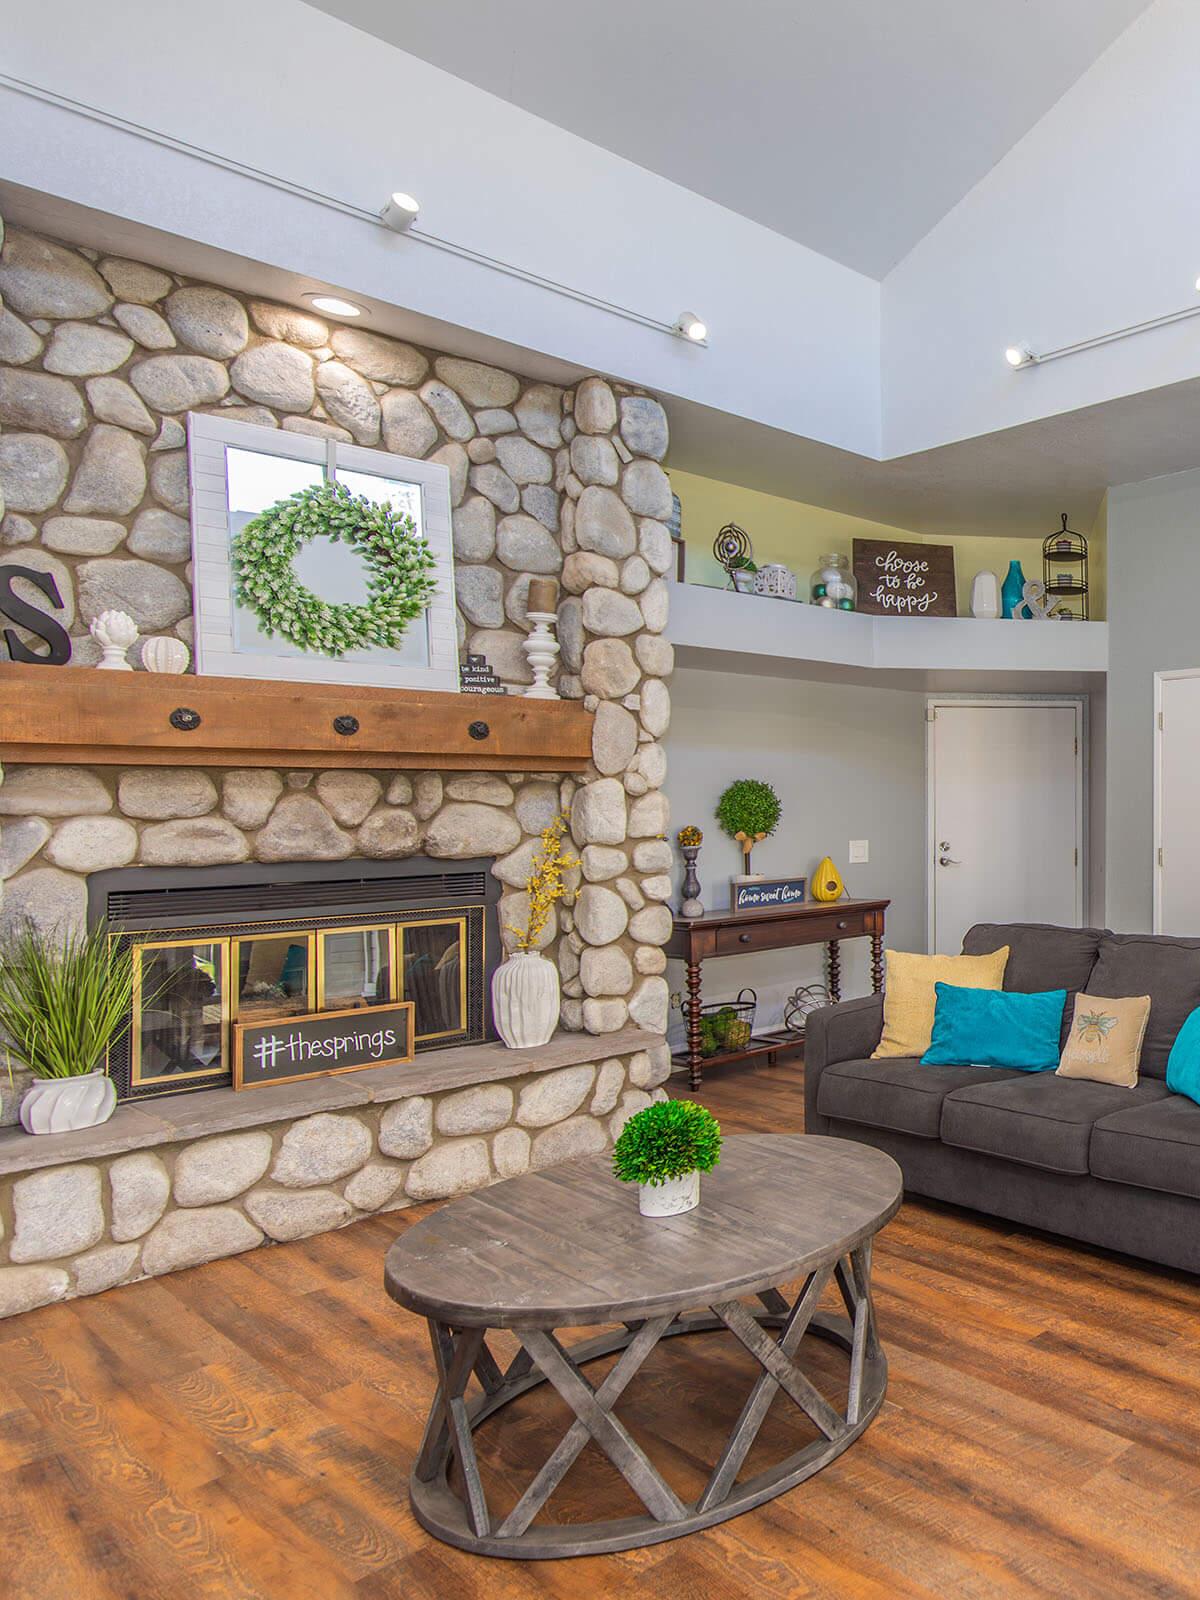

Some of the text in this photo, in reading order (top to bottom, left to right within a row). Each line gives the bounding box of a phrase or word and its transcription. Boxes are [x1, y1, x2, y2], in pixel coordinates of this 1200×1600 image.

[875, 550, 929, 574] choose
[878, 573, 925, 590] to be
[869, 584, 938, 613] happy
[0, 564, 72, 666] S
[463, 675, 496, 684] positive
[471, 665, 490, 673] kind
[252, 1030, 397, 1069] #thesprings
